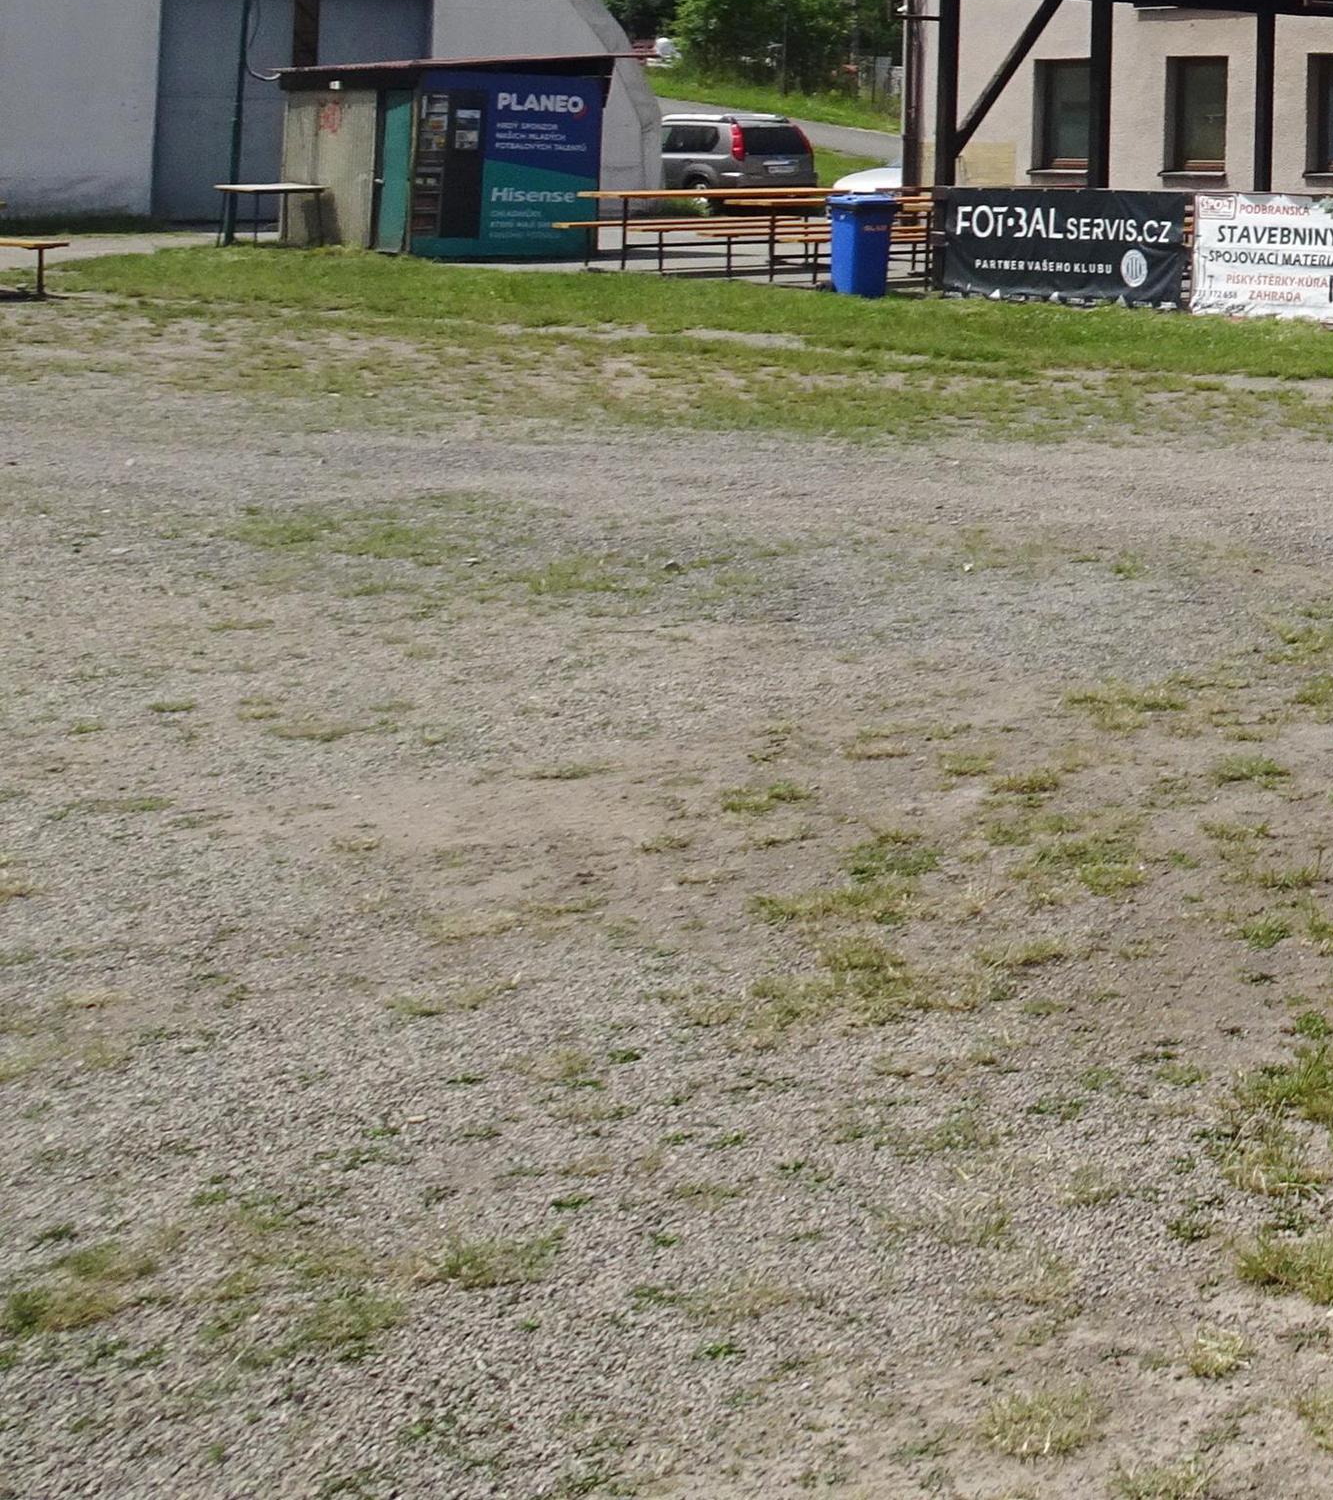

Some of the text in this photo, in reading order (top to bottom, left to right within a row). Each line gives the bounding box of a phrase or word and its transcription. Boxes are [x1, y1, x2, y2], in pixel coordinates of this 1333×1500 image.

[497, 92, 584, 113] PLANEO
[491, 187, 576, 202] Hisense
[975, 258, 1113, 274] PARTNER VAŠEHO KLUBU
[1248, 290, 1302, 303] ZAHRADA
